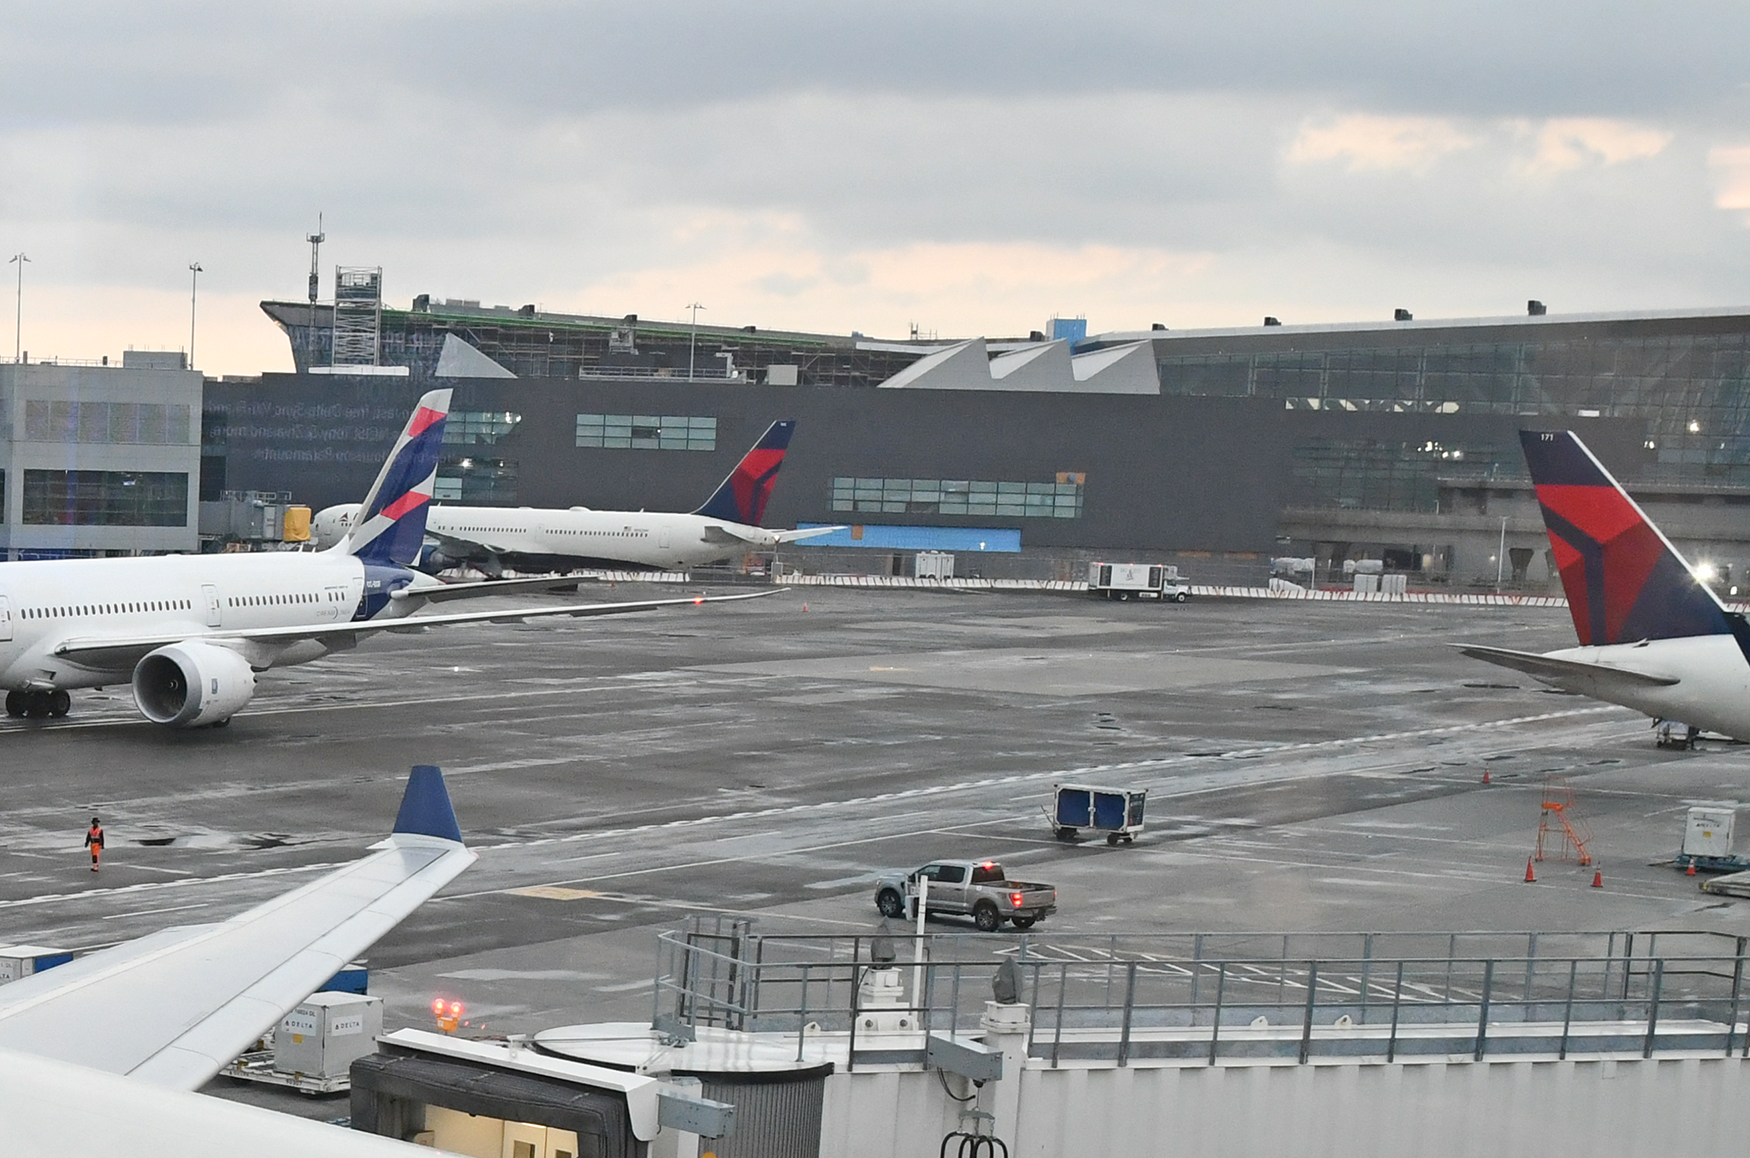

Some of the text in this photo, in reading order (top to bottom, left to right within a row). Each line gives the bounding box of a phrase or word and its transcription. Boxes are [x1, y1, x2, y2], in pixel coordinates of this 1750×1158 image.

[1540, 433, 1554, 441] 171
[291, 1021, 313, 1029] DELTA
[340, 1021, 360, 1029] DELTA
